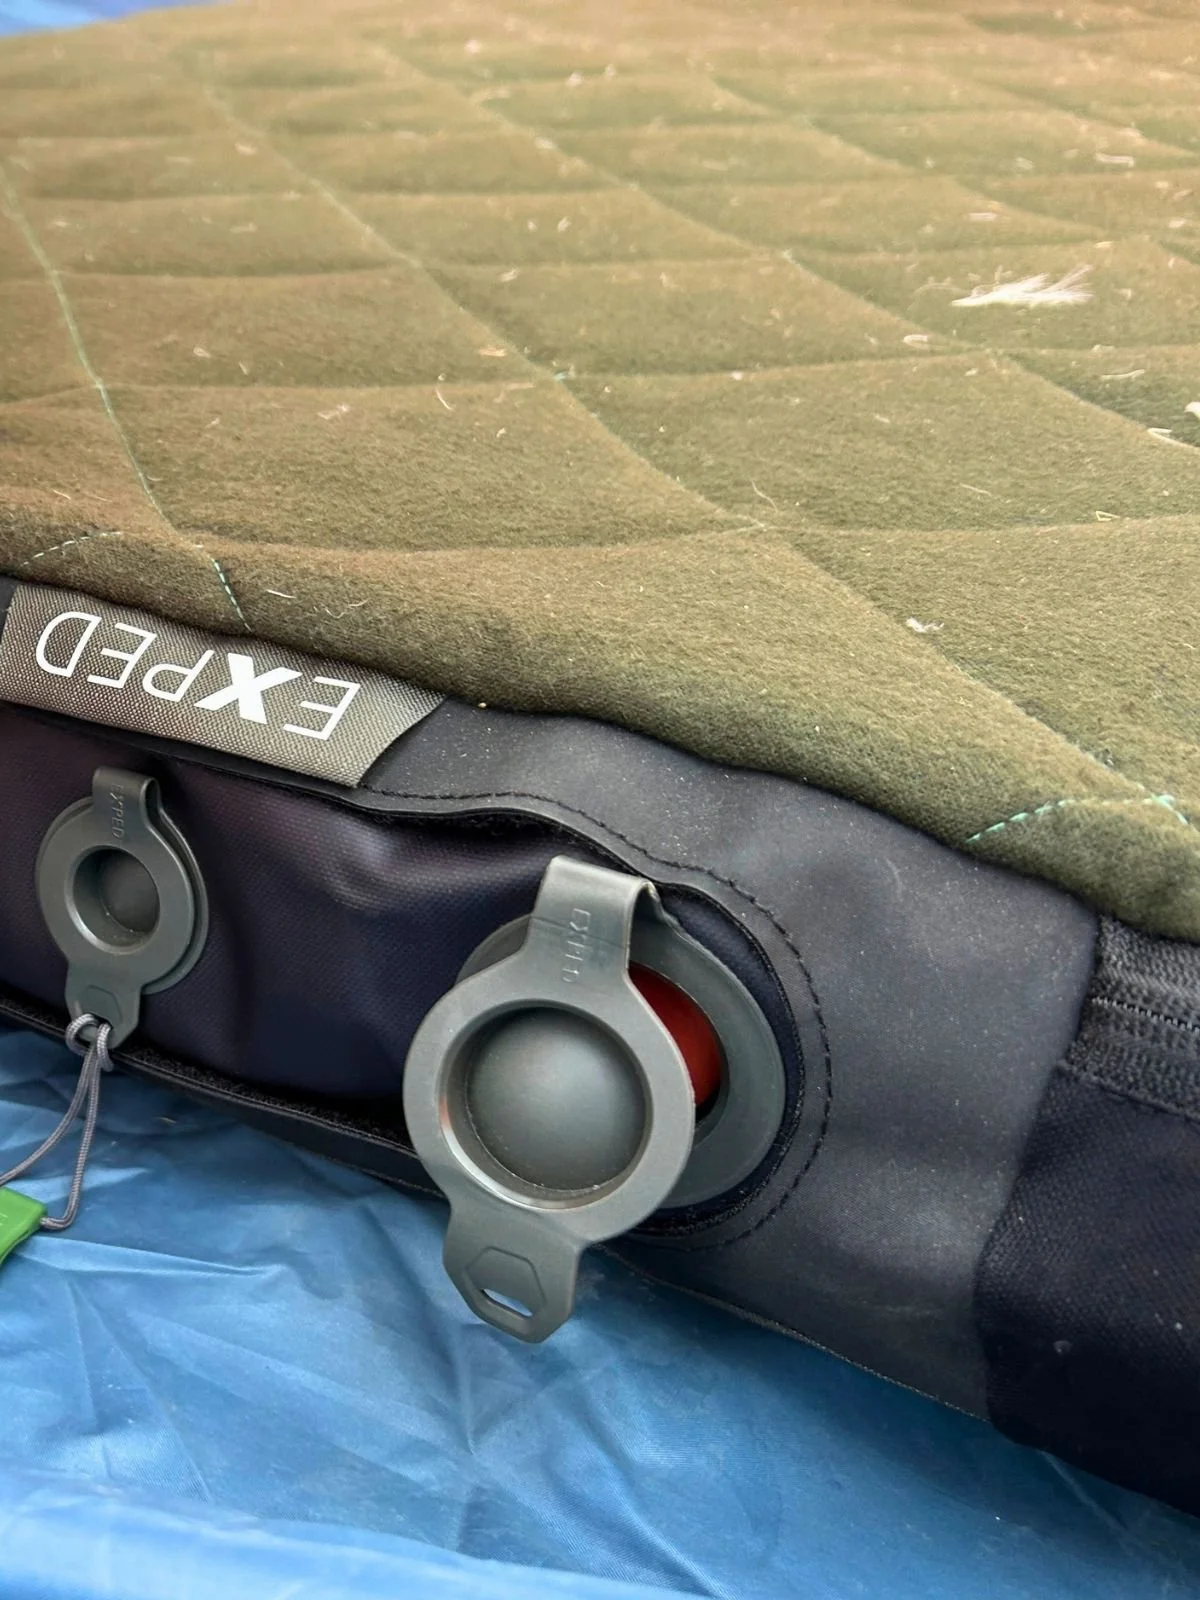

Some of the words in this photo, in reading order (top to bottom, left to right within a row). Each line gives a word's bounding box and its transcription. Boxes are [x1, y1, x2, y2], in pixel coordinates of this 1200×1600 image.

[35, 611, 361, 740] EXPED
[109, 782, 126, 839] EXPED
[561, 908, 591, 983] EXPED
